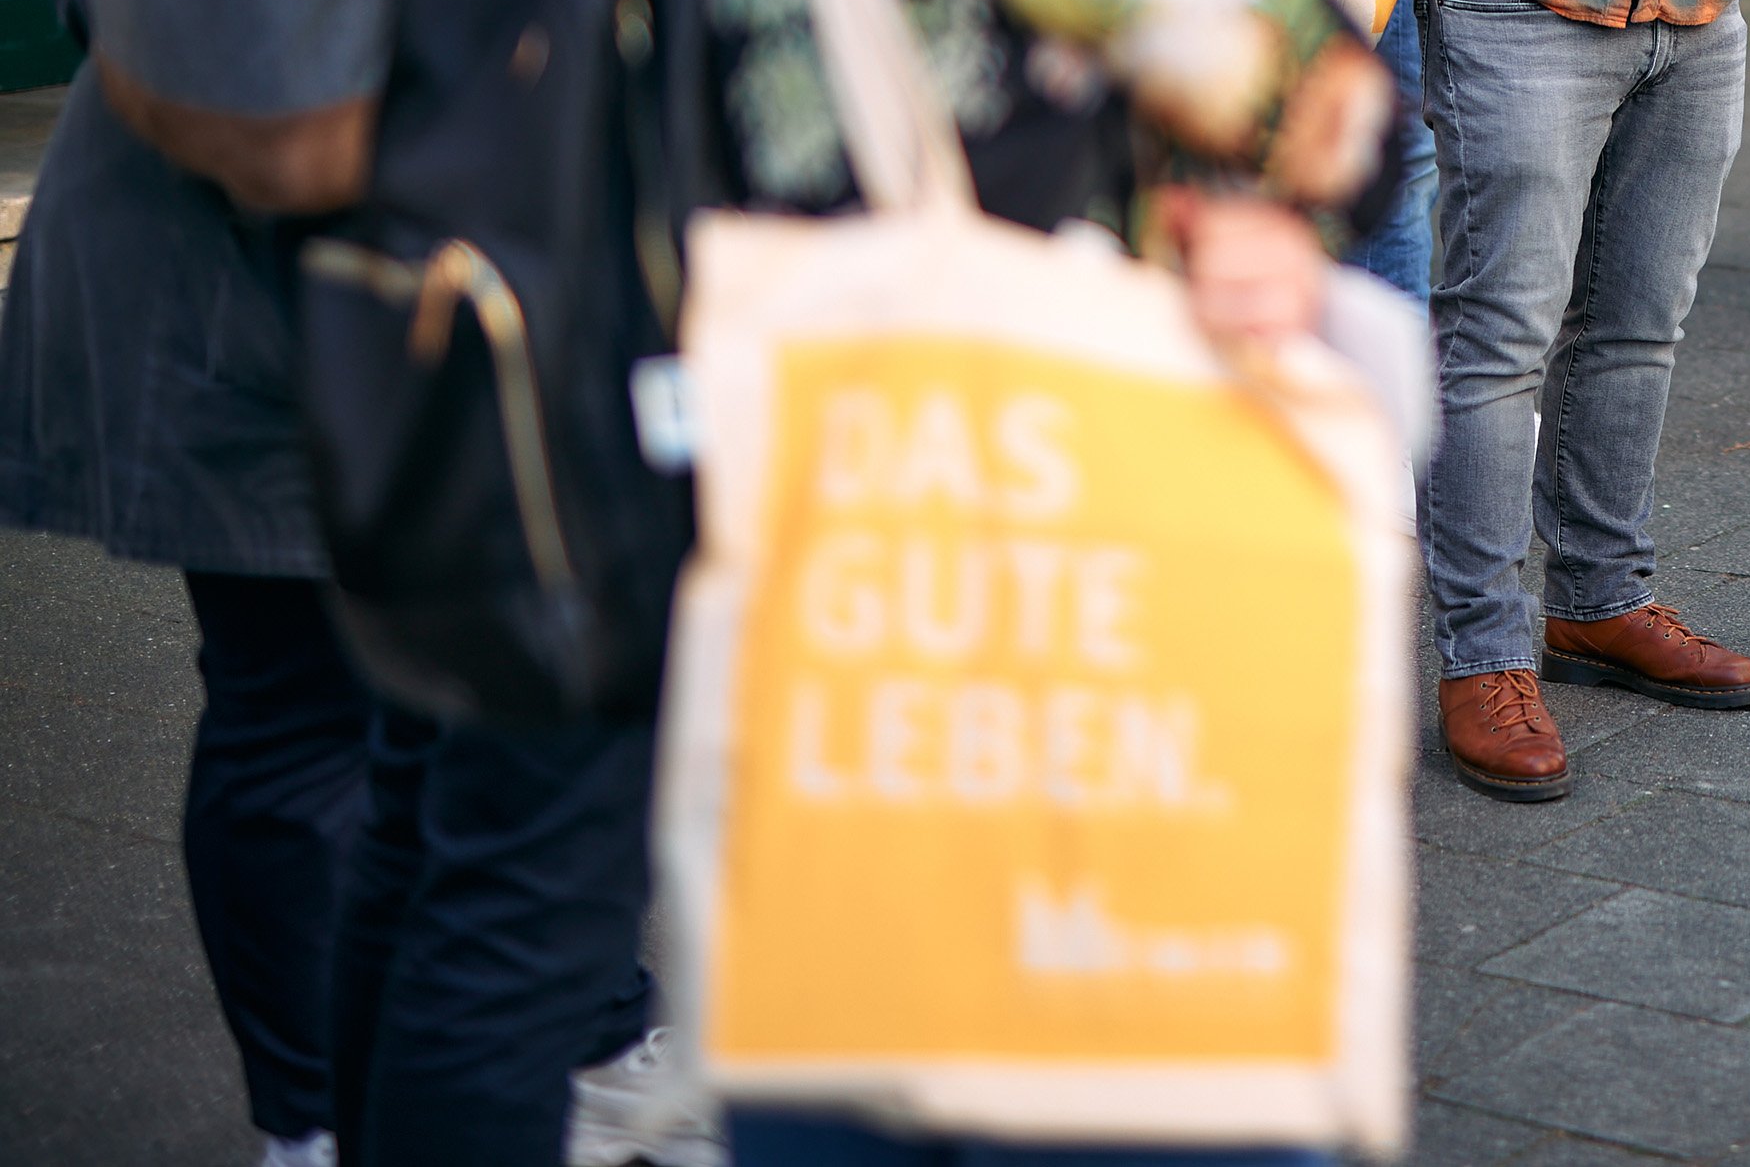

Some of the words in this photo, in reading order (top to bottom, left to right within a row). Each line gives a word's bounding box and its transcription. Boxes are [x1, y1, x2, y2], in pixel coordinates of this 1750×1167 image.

[816, 386, 1082, 519] DAS
[798, 527, 1147, 671] GUTE
[786, 675, 1236, 815] LEBEN.
